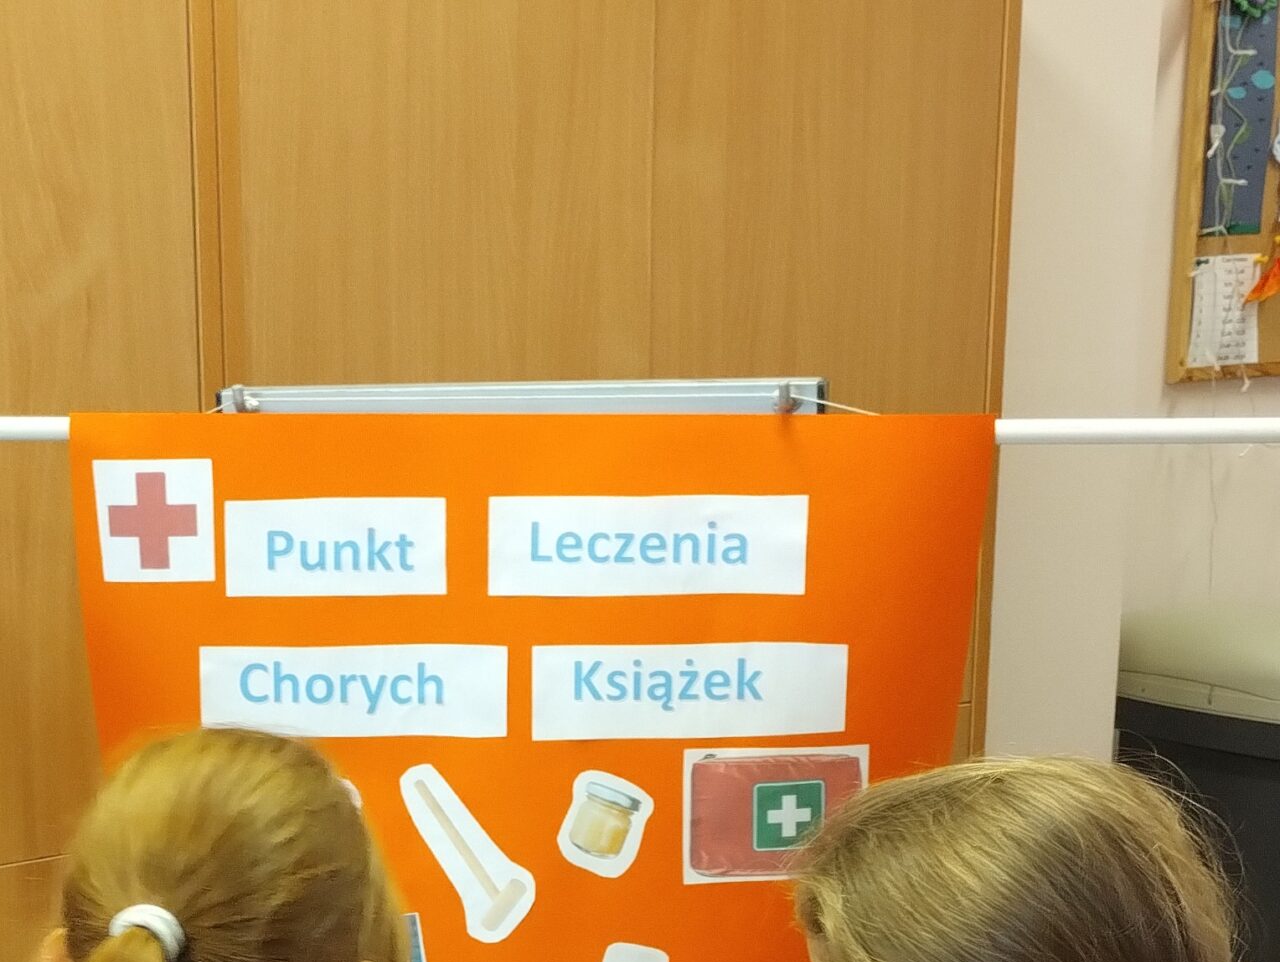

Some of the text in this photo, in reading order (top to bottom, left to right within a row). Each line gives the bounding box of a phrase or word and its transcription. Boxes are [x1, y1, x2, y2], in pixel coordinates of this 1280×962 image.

[265, 520, 751, 573] Punkt Leczenia
[238, 656, 764, 716] Chorych Książek
